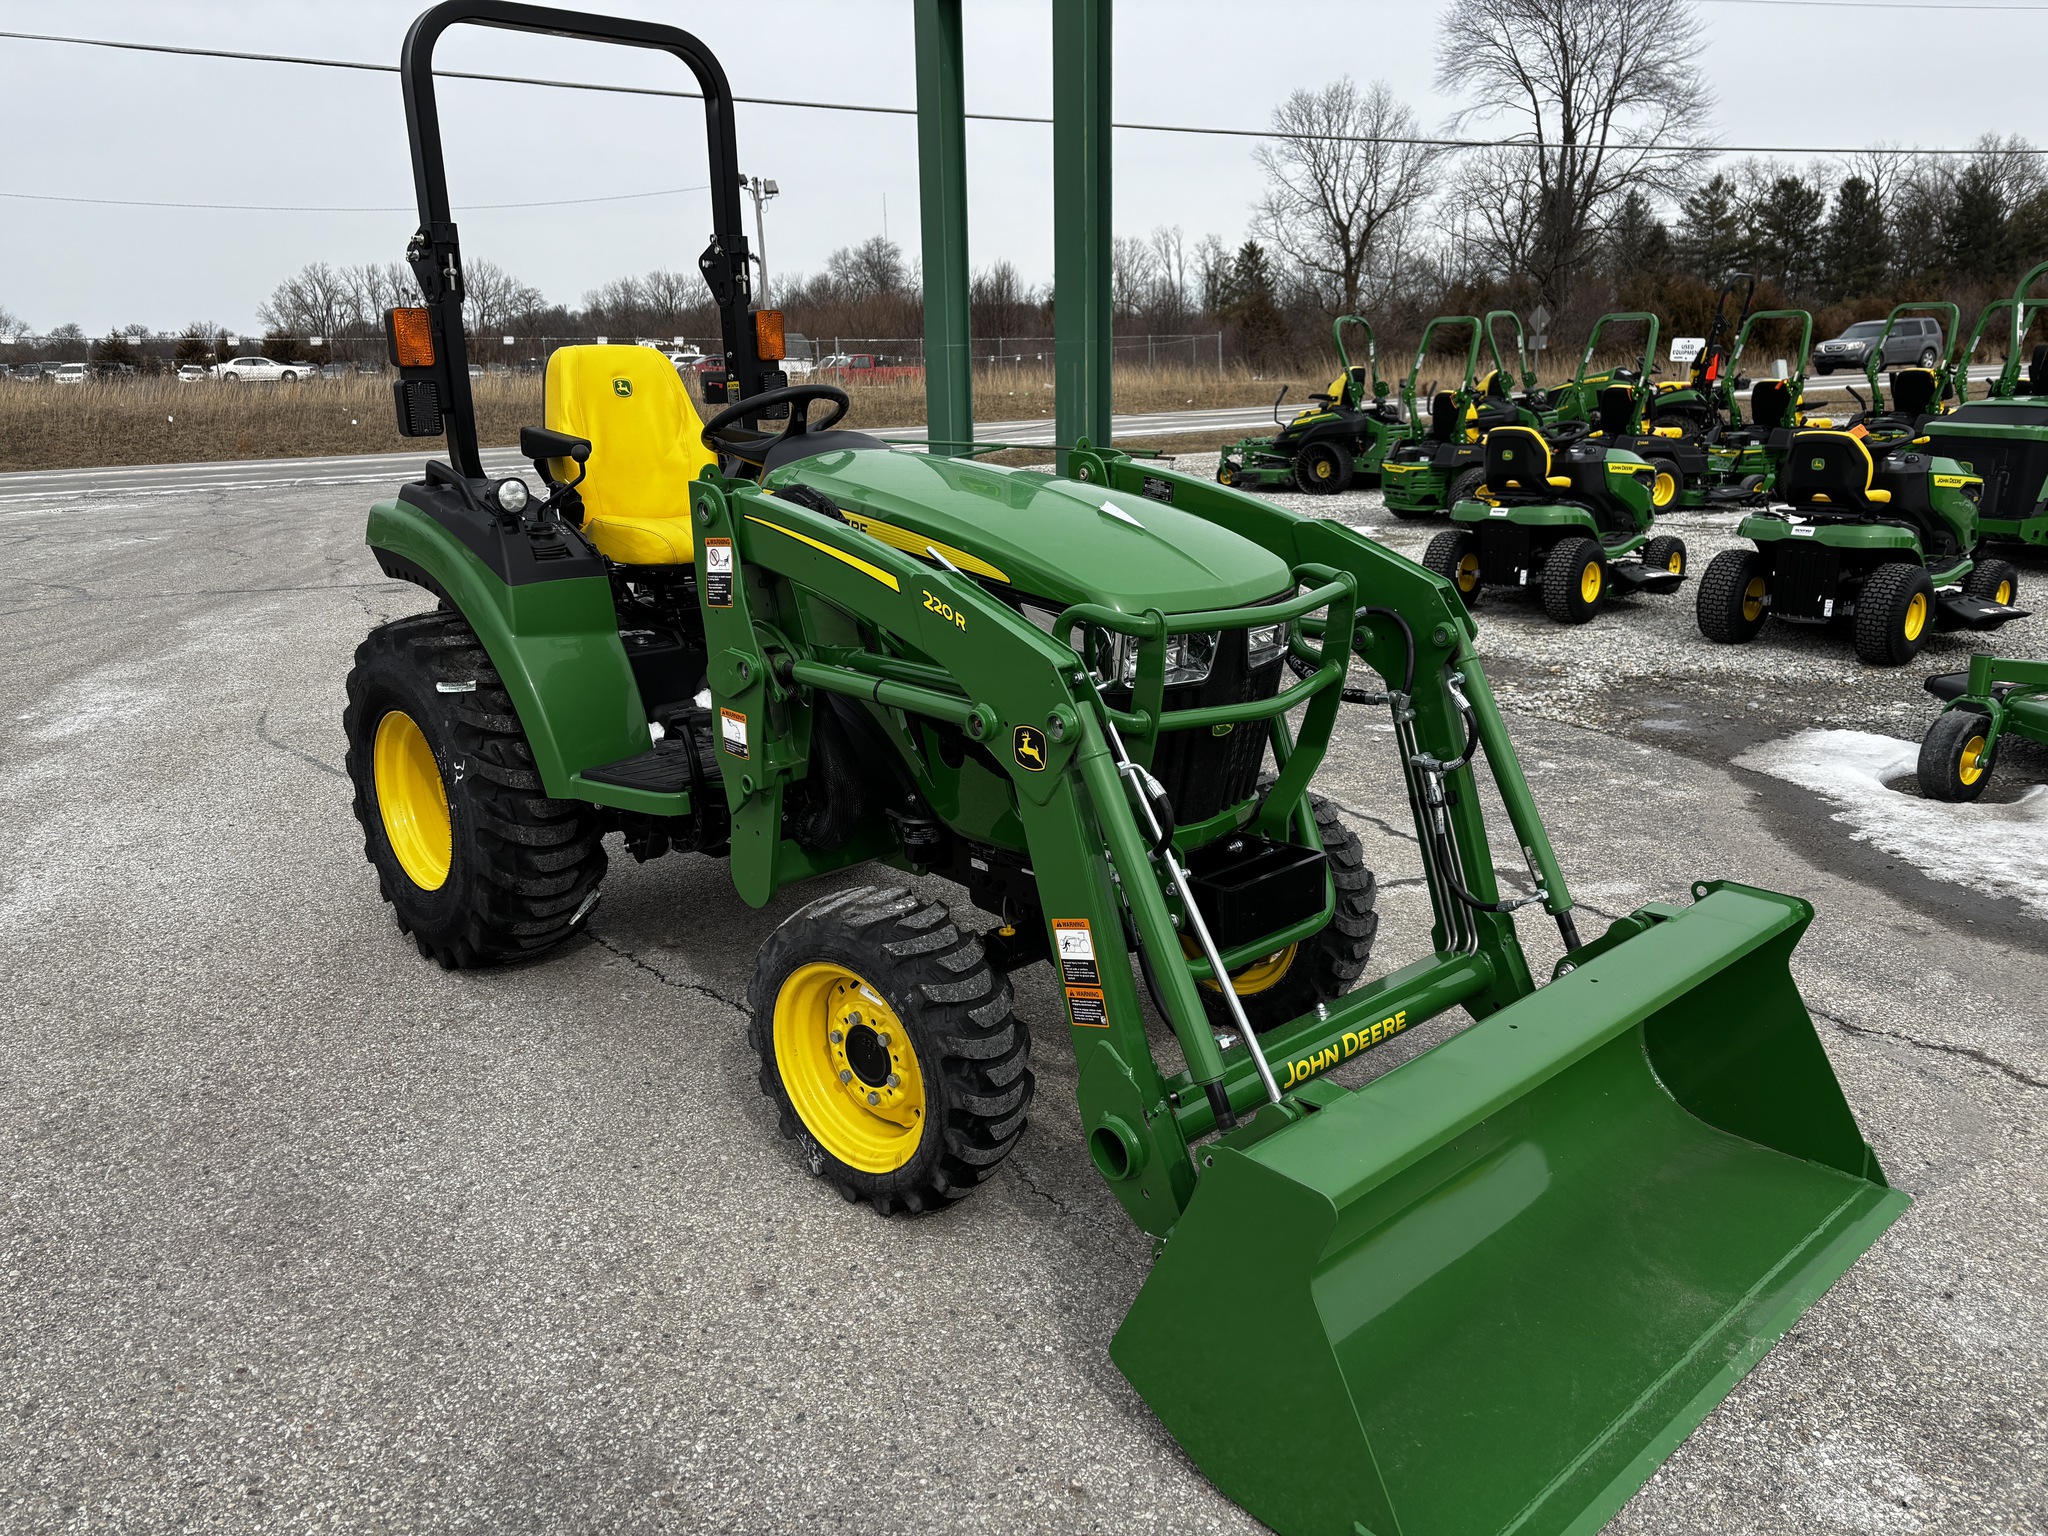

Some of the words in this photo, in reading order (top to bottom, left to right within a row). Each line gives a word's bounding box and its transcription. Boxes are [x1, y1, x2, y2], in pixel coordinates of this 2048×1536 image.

[1949, 477, 1962, 485] DEERE
[1062, 920, 1086, 928] WARNING
[1076, 990, 1100, 998] WARNING
[1283, 1043, 1340, 1089] JOHN
[1341, 1010, 1407, 1058] DEERE
